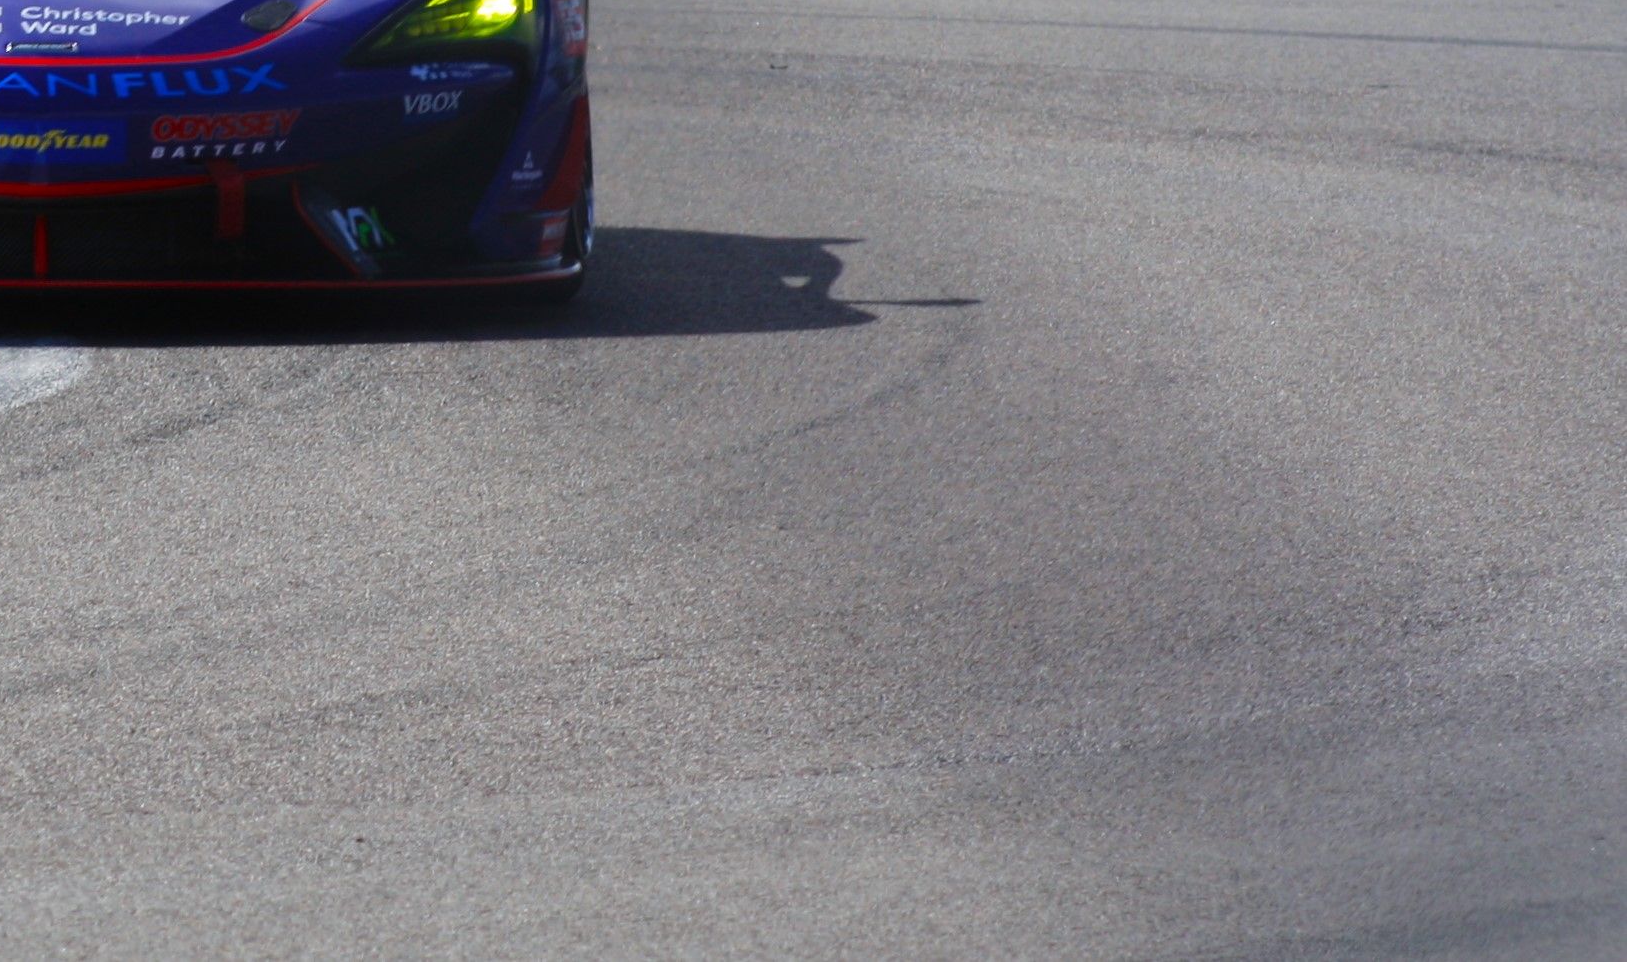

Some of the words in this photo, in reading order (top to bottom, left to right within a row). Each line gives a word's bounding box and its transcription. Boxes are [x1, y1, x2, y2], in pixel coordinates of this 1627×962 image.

[20, 6, 191, 28] Christopher
[21, 21, 97, 37] Ward
[404, 90, 462, 114] VBOX
[151, 108, 302, 143] ODYSSEY
[150, 139, 286, 159] BATTERY
